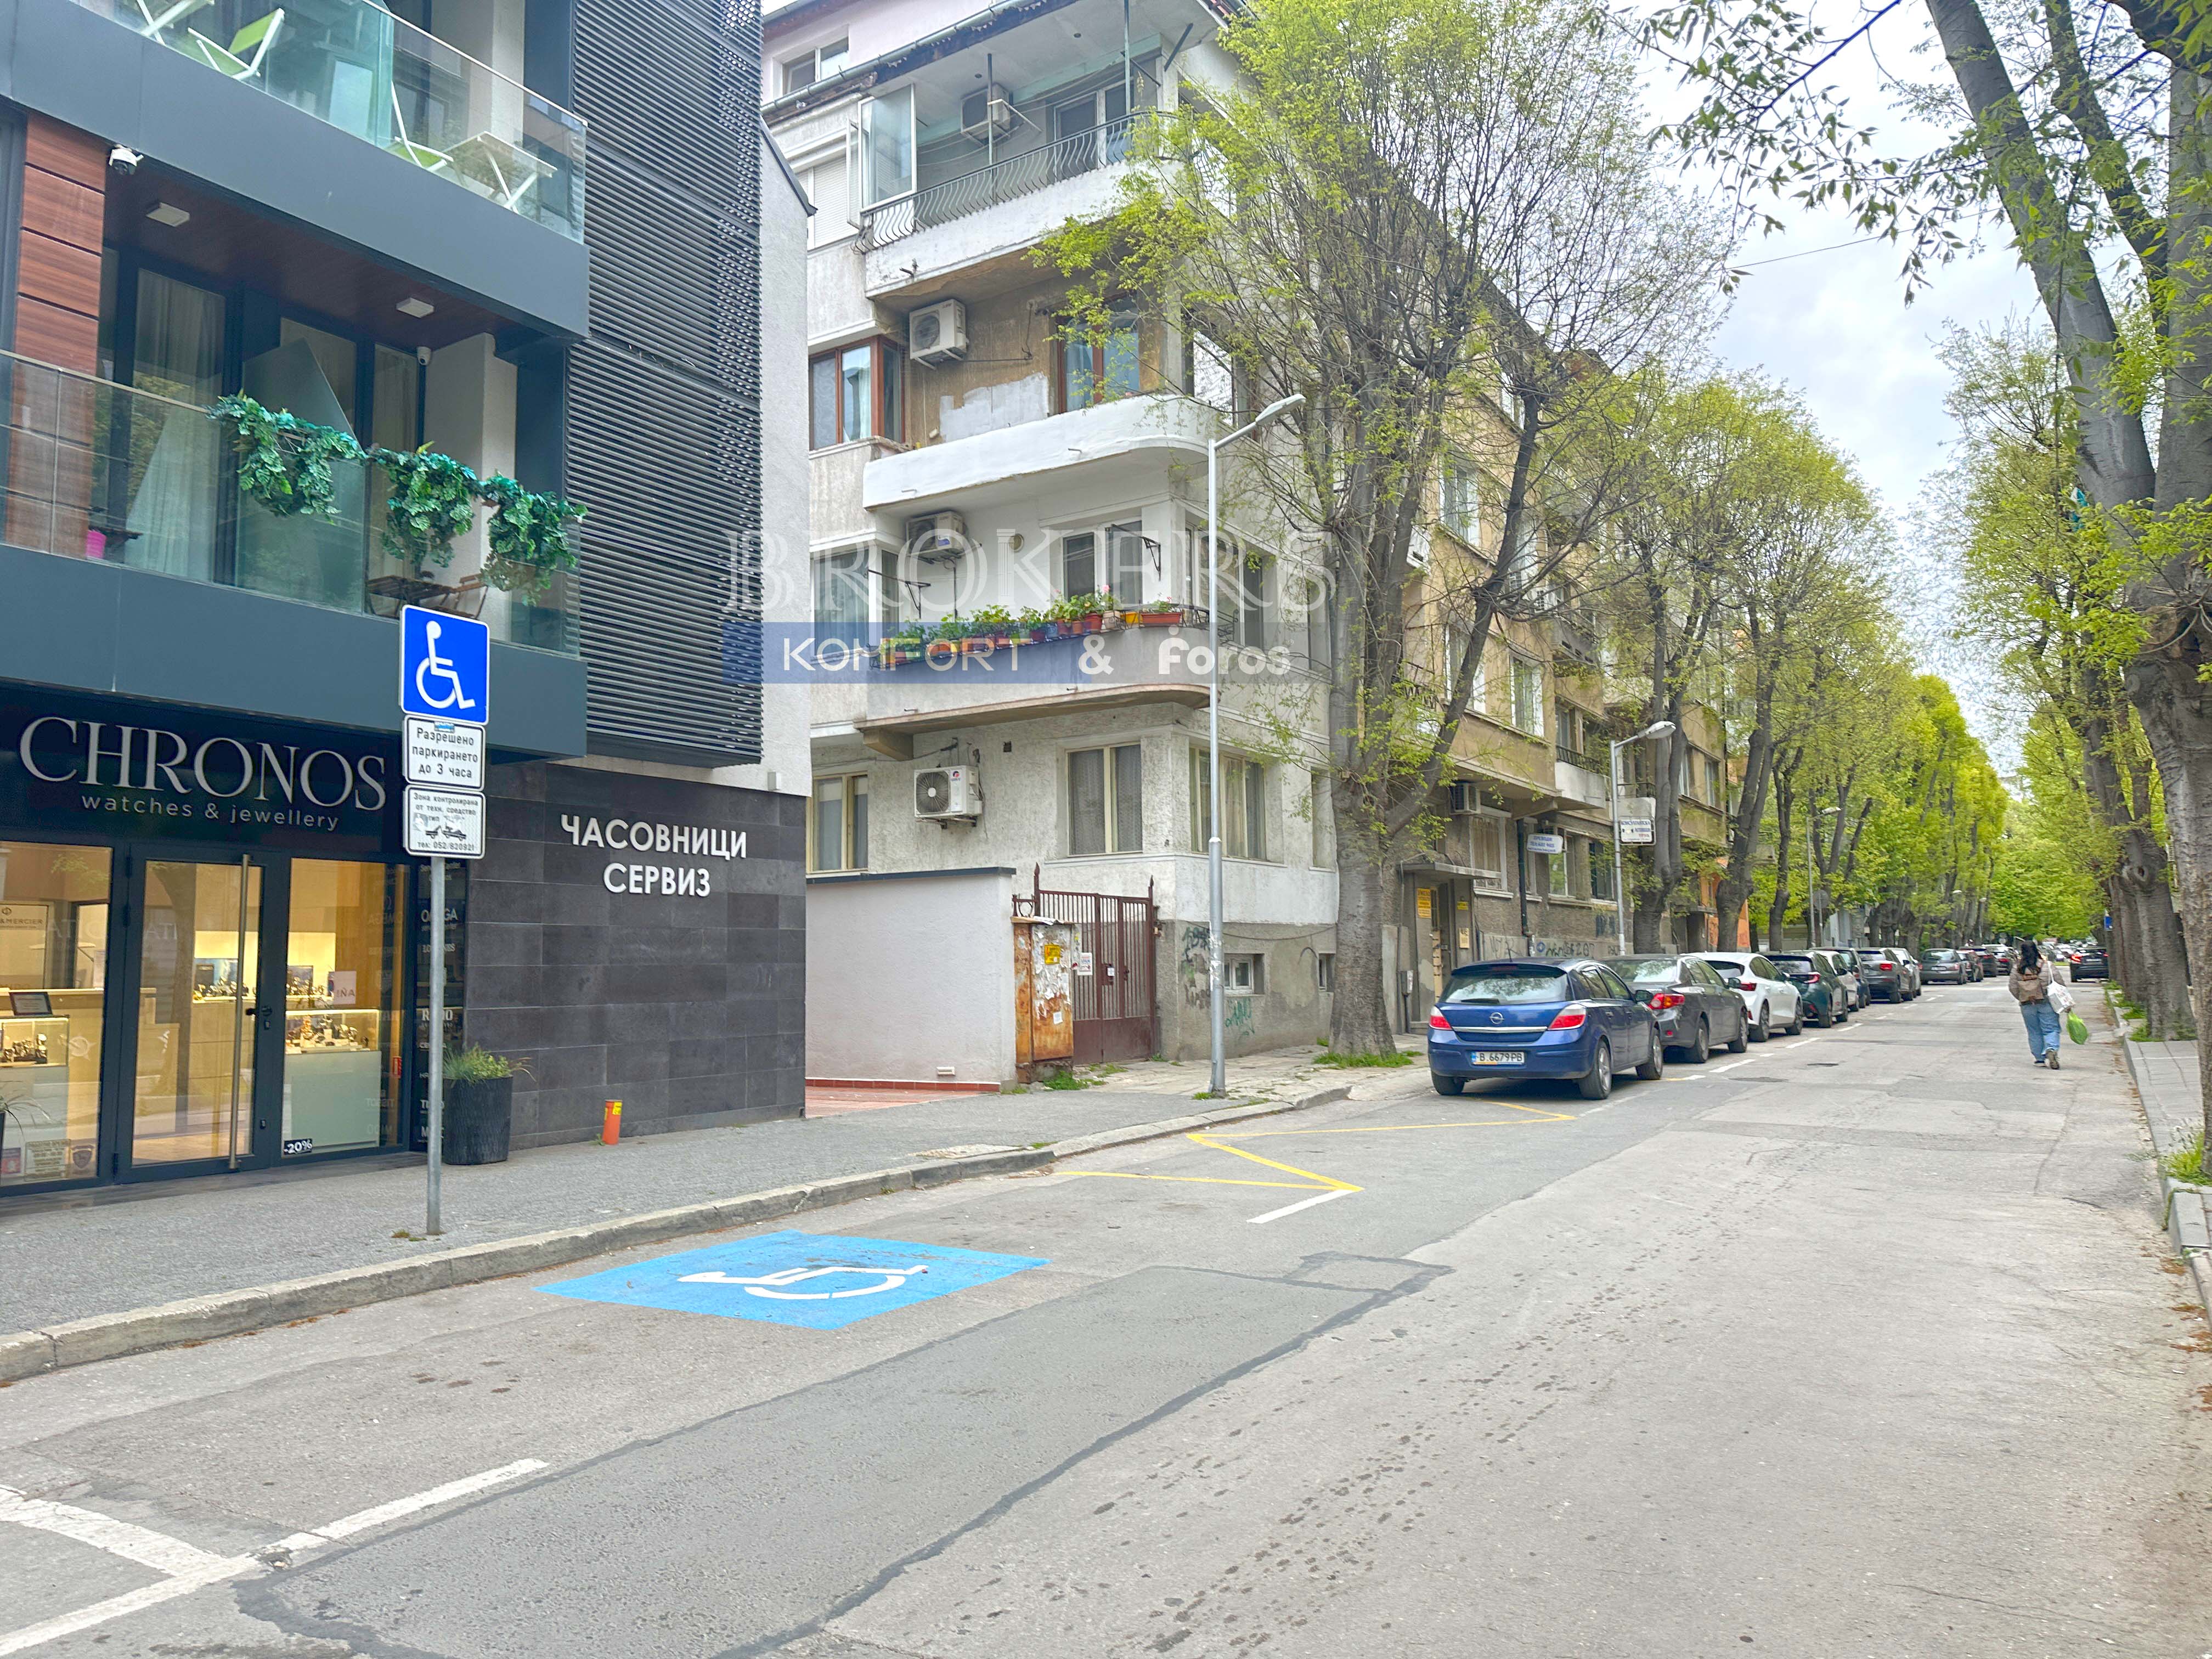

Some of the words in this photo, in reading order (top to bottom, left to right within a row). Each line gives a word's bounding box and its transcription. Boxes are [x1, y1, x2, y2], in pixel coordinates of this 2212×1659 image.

[417, 727, 474, 746] Разрешено
[20, 716, 386, 811] CHRONOS
[412, 746, 478, 763] паркирането
[418, 764, 431, 775] до
[437, 763, 443, 775] 3
[449, 768, 472, 778] часа
[414, 792, 431, 802] Зона
[82, 795, 193, 817] watches
[205, 803, 219, 819] &
[229, 804, 339, 832] jewellery
[560, 814, 747, 861] ЧАСОВНИЦИ
[603, 862, 711, 897] СЕРВИЗ
[283, 1139, 313, 1154] -20%
